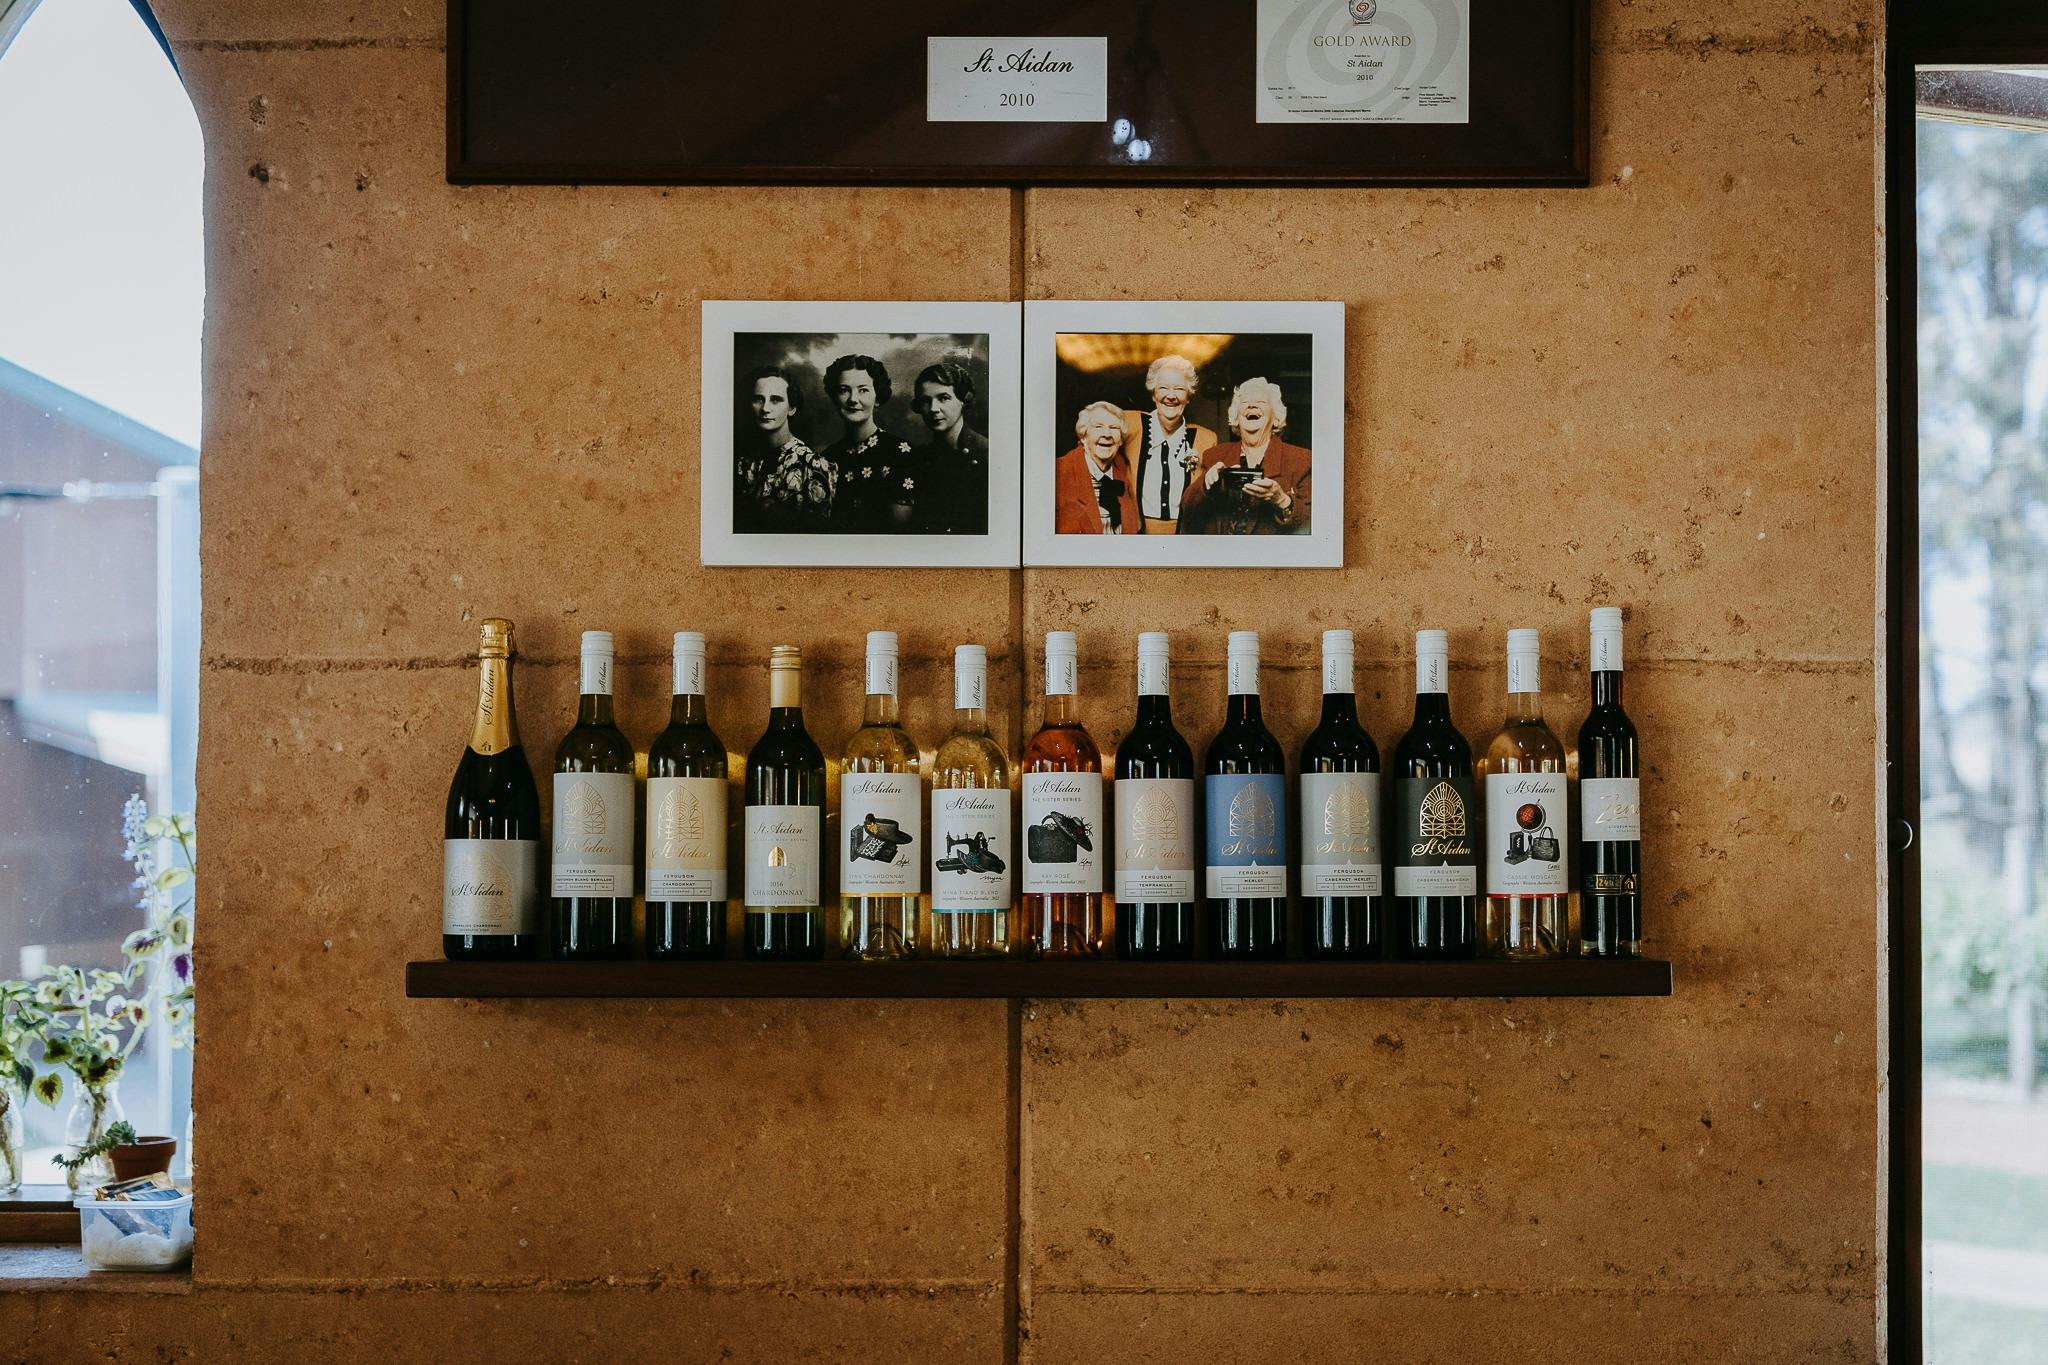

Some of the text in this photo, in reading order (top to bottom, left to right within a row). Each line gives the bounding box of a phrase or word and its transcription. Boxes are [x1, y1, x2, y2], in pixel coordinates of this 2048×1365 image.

[1313, 35, 1412, 47] GOLD AWARD
[998, 47, 1075, 73] Aidan
[1346, 59, 1383, 68] St Aidan
[999, 93, 1035, 107] 2010
[1436, 839, 1471, 855] Aidan
